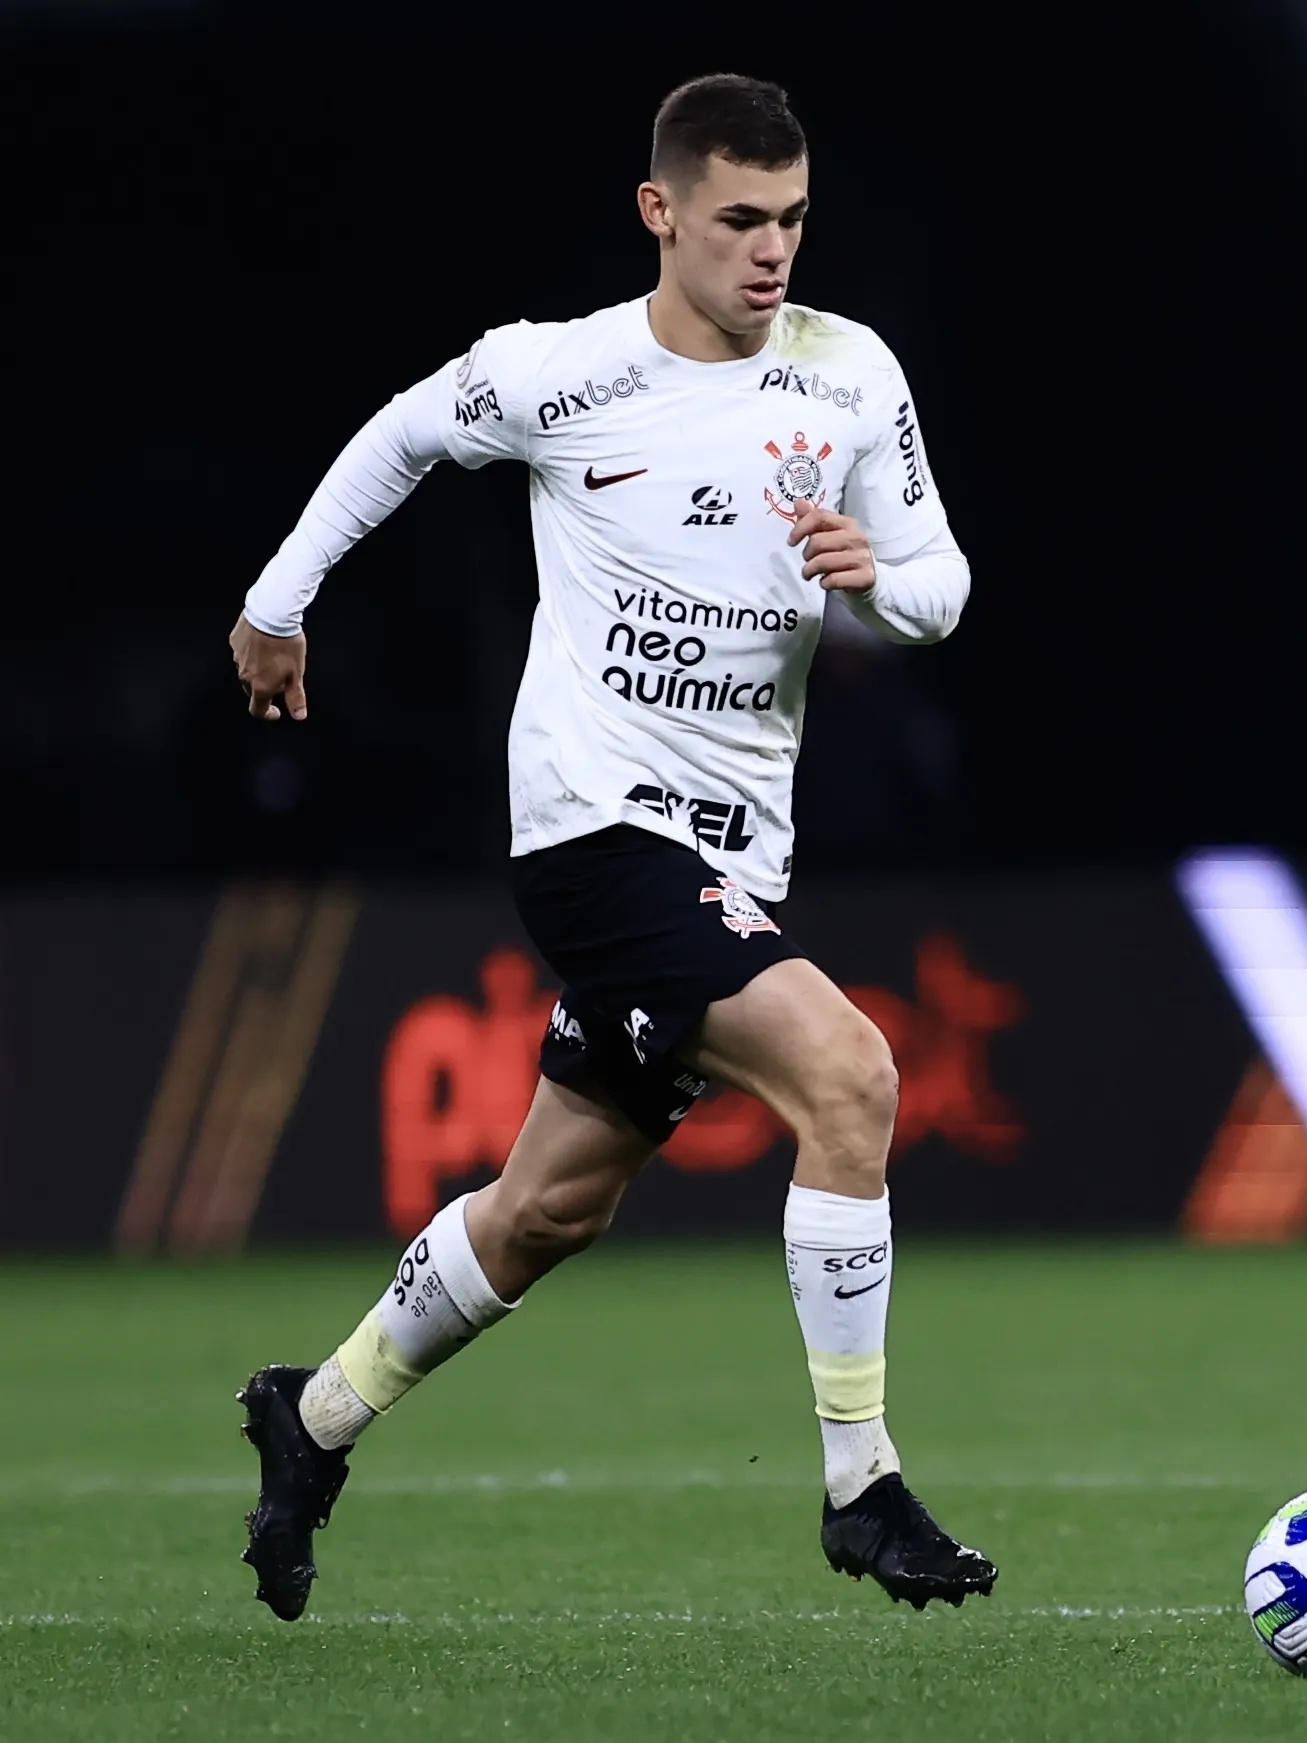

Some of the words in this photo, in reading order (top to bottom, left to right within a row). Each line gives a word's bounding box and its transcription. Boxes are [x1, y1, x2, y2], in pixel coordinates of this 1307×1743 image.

[538, 365, 650, 430] pixbet
[759, 365, 864, 417] pixbet
[899, 423, 925, 507] bmg
[681, 513, 739, 526] ALE
[613, 588, 799, 632] vitaminas
[605, 622, 707, 667] neo
[602, 666, 776, 712] química
[411, 1296, 429, 1318] de
